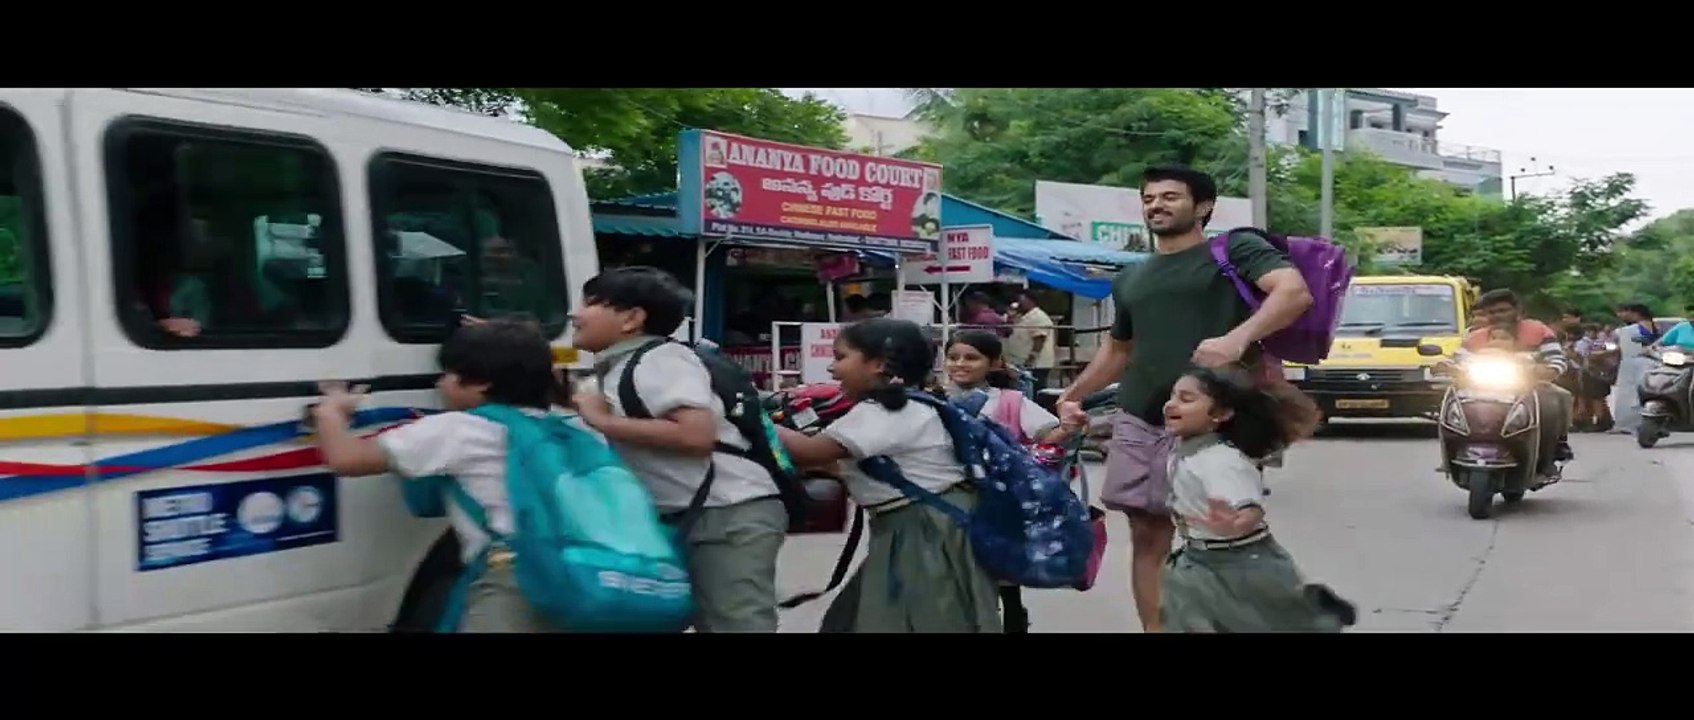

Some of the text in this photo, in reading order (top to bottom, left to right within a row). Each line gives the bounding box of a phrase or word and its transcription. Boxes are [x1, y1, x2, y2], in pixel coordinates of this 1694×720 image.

[728, 143, 923, 188] ANANYA FOOD COURT
[825, 206, 849, 218] FAST
[850, 208, 877, 220] FOOD
[947, 247, 966, 260] FAST
[967, 246, 989, 259] FOOD
